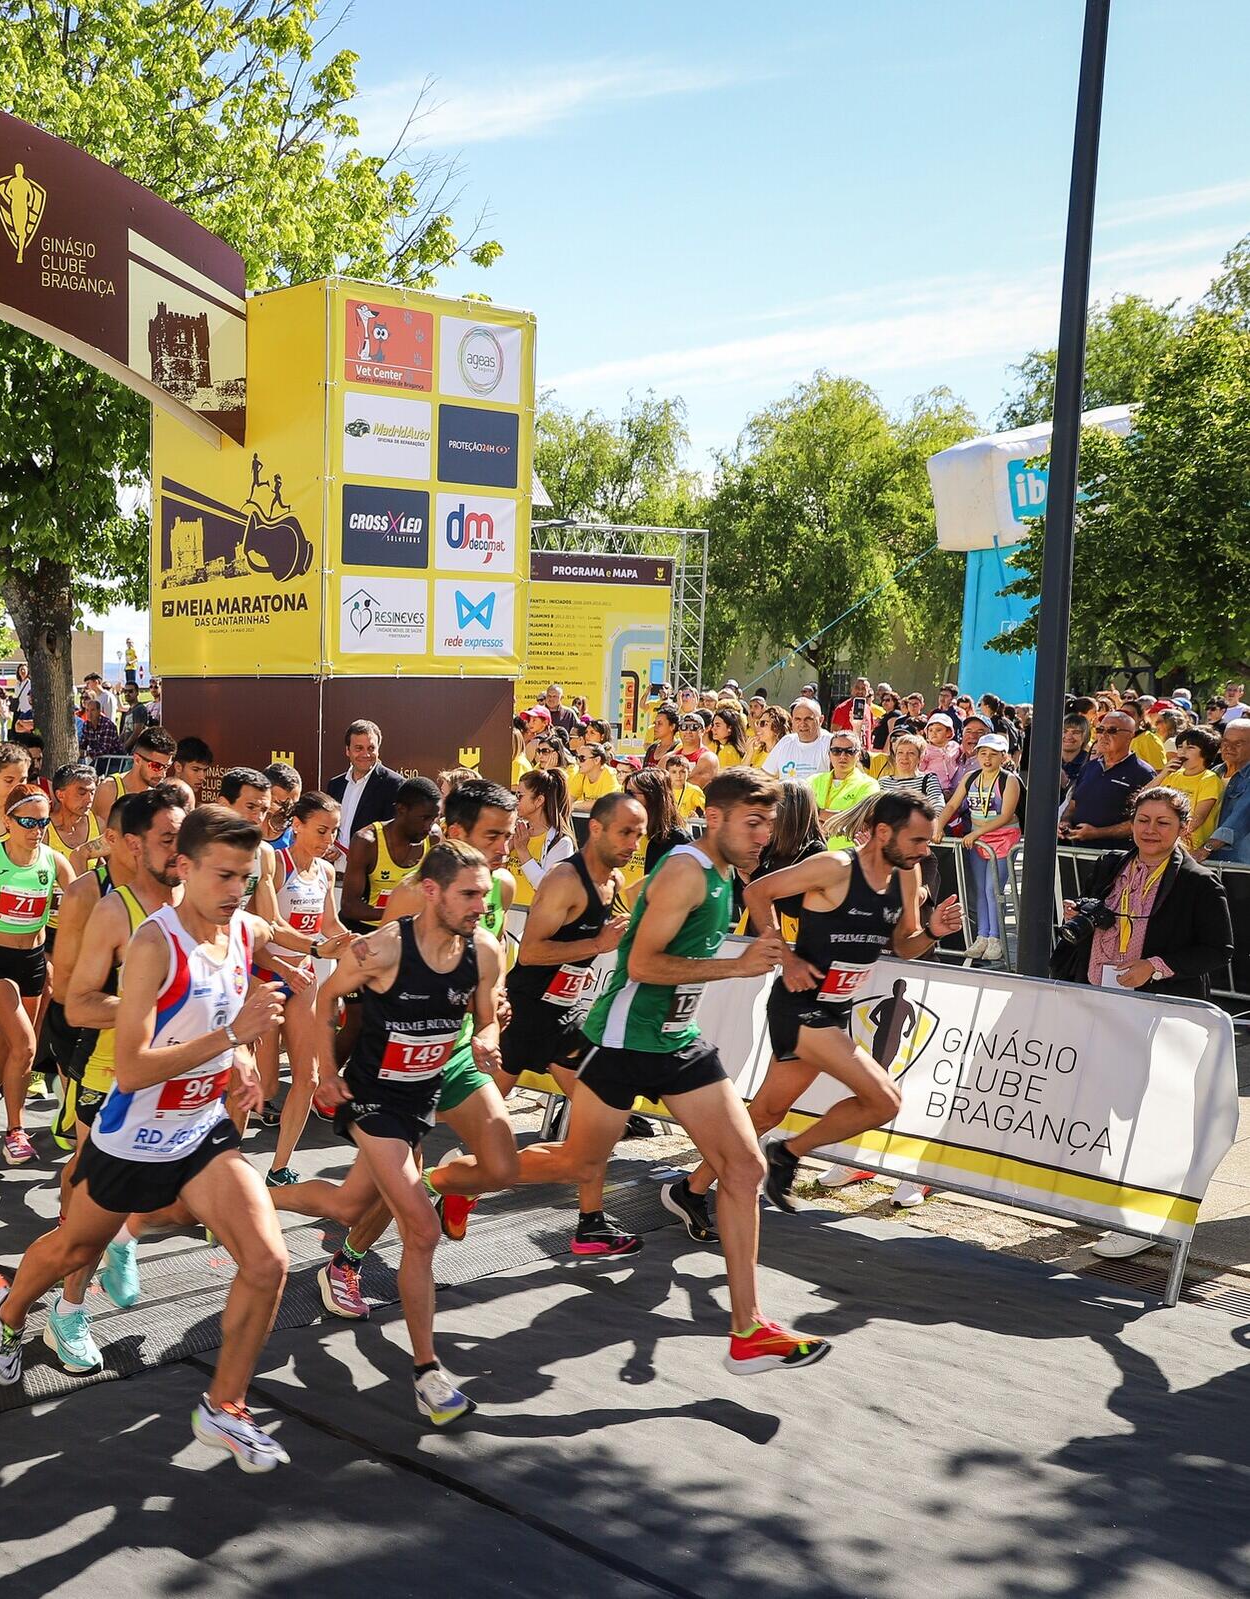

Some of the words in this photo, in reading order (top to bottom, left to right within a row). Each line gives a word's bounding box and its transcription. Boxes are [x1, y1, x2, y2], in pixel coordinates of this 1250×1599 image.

[40, 236, 96, 259] GINÁSIO
[40, 255, 87, 275] CLUBE
[40, 272, 116, 299] BRAGANÇA
[466, 353, 496, 370] ageas
[355, 364, 372, 377] Vet
[373, 367, 403, 381] Center
[448, 440, 495, 454] PROTEÇÃO24H
[468, 537, 506, 552] decomat
[552, 565, 605, 577] PROGRAMA
[605, 570, 611, 578] e
[612, 568, 638, 579] MAPA
[176, 599, 214, 617] MEIA
[216, 592, 308, 615] MARATONA
[195, 617, 210, 627] DAS
[212, 614, 270, 626] CANTARINHAS
[374, 611, 425, 624] RESINEVES
[444, 635, 463, 647] rede
[464, 636, 504, 650] expressos
[627, 685, 633, 693] C
[201, 778, 222, 790] CLUB
[14, 896, 35, 912] 71
[300, 914, 318, 929] 95
[384, 1019, 426, 1032] PRIME
[401, 1044, 446, 1065] 149
[942, 1027, 1078, 1075] GINÁSIO
[182, 1077, 215, 1100] 96
[932, 1059, 1048, 1104] CLUBE
[926, 1091, 1113, 1157] BRAGANÇA
[135, 1127, 163, 1144] RD
